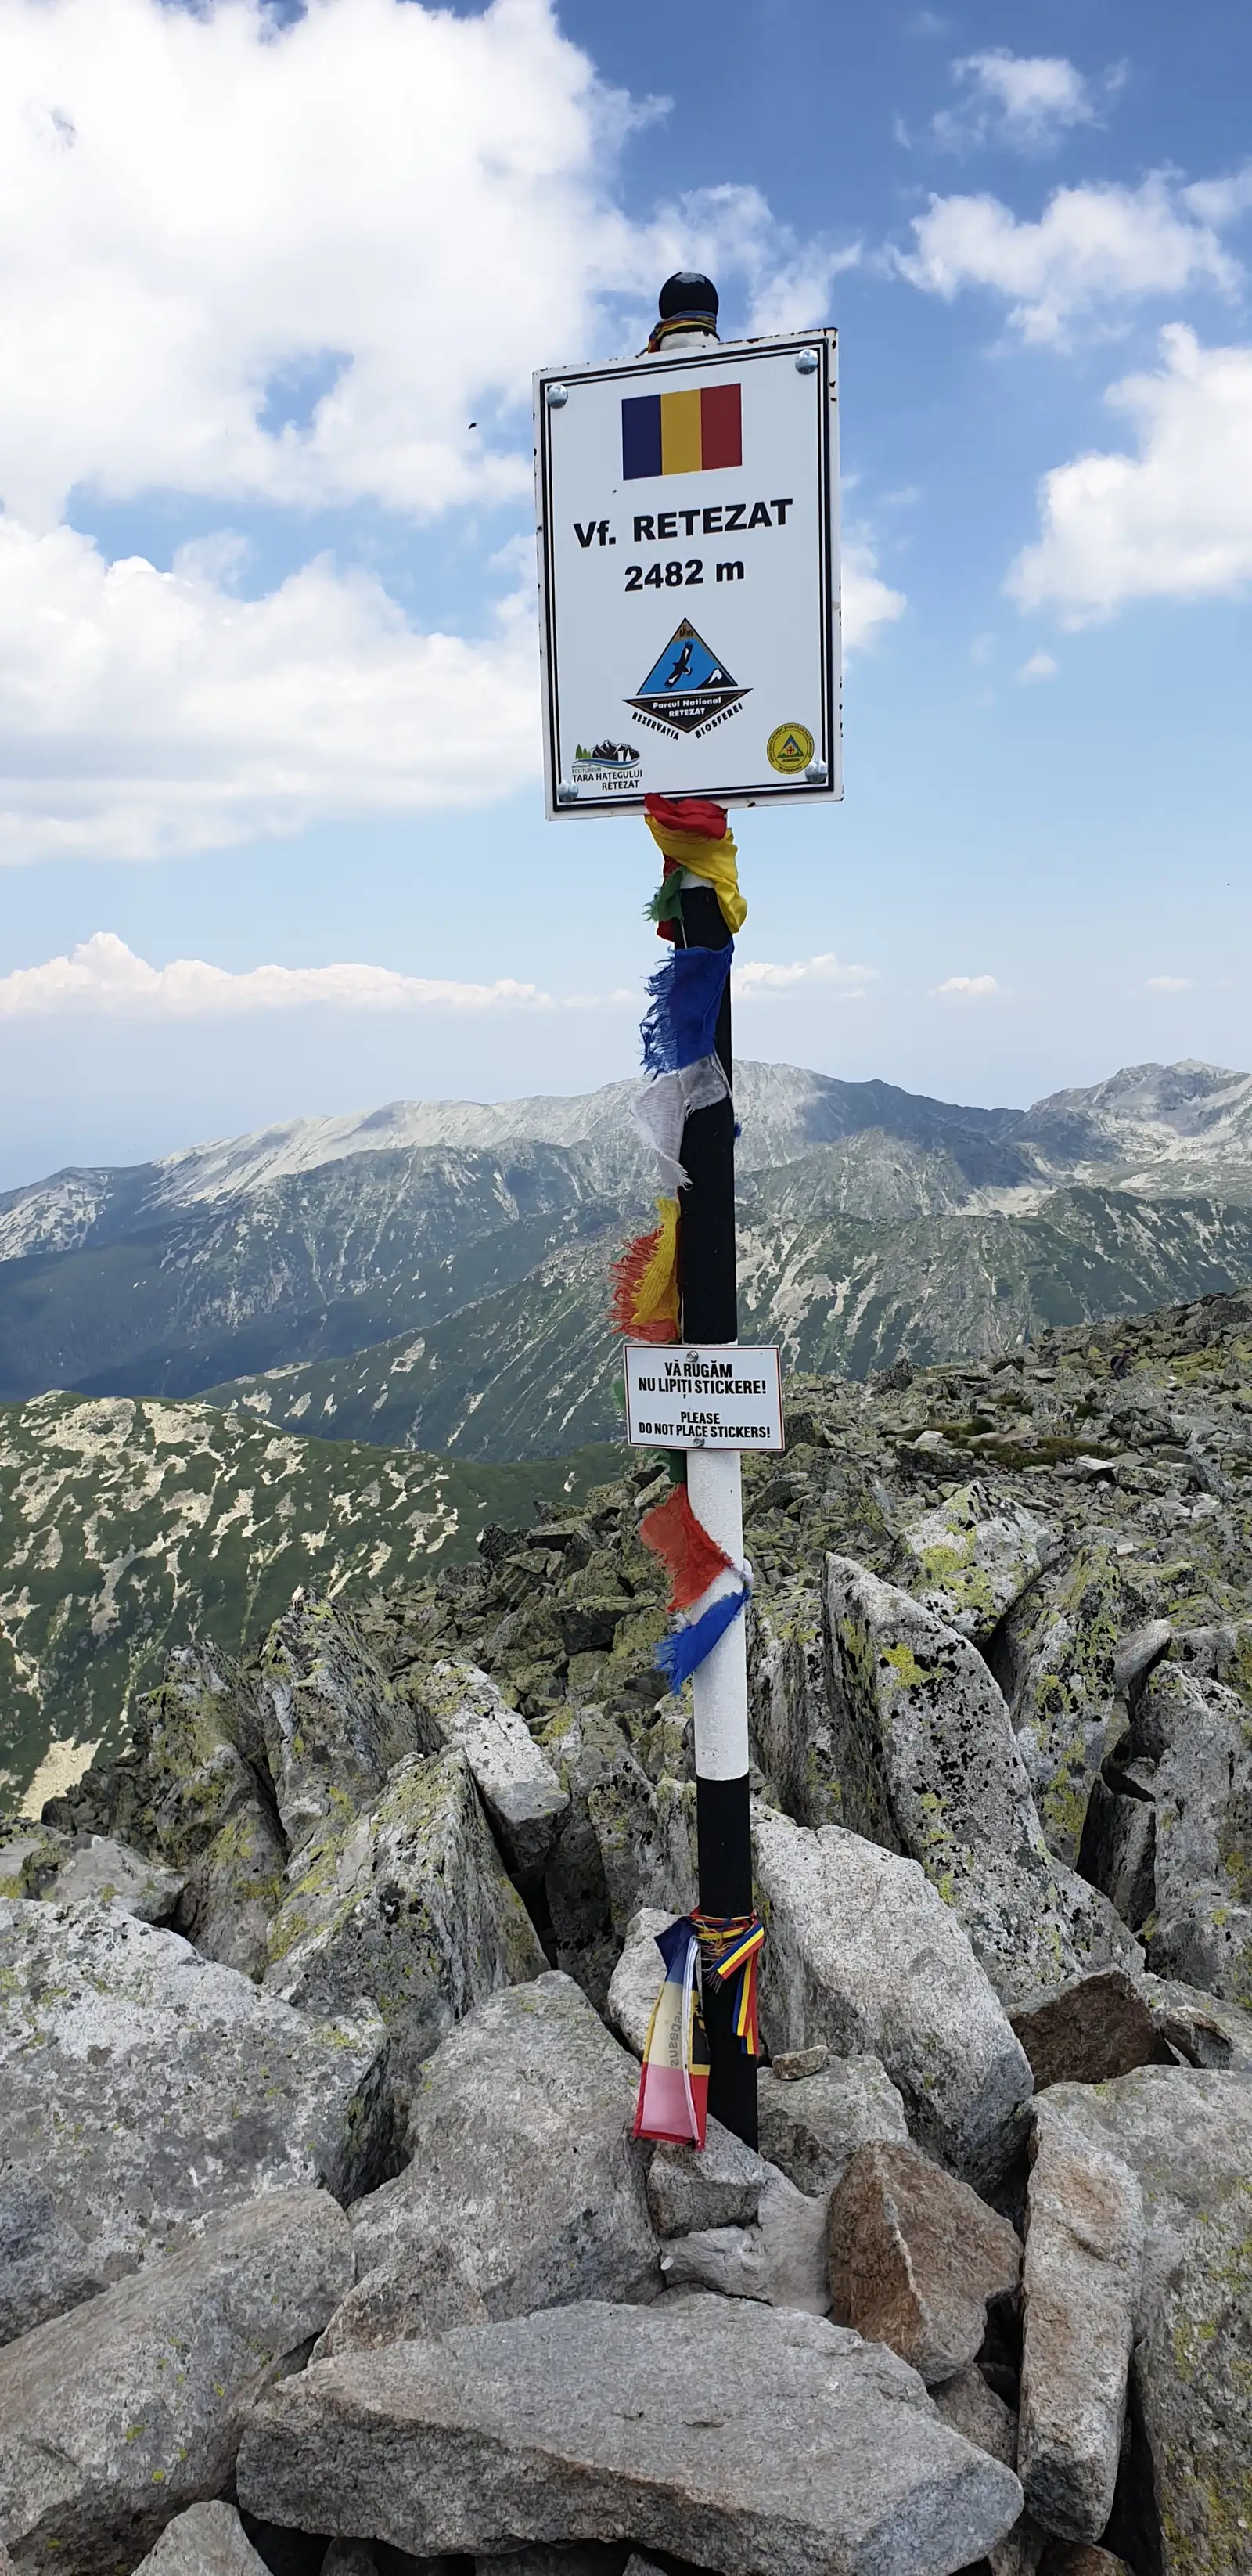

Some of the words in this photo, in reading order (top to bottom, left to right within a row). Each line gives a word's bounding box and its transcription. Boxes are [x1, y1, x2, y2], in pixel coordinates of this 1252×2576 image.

[573, 520, 617, 548] Vf.
[633, 498, 793, 542] RETEZAT
[625, 559, 704, 592] 2482
[716, 560, 745, 582] m
[653, 701, 680, 709] Parcul
[668, 708, 706, 717] RETEZAT
[695, 701, 743, 739] BIOSFEREI
[602, 780, 640, 791] RETEZAT
[664, 1359, 682, 1376] VĂ
[683, 1360, 732, 1378] RUGĂM
[639, 1378, 655, 1391] NU
[658, 1378, 693, 1399] LIPIȚI
[695, 1380, 766, 1394] STICKERE!
[681, 1412, 720, 1424] PLEASE
[639, 1422, 652, 1433] DO
[654, 1424, 675, 1436] NOT
[676, 1425, 708, 1437] PLACE
[711, 1426, 771, 1438] STICKERS!
